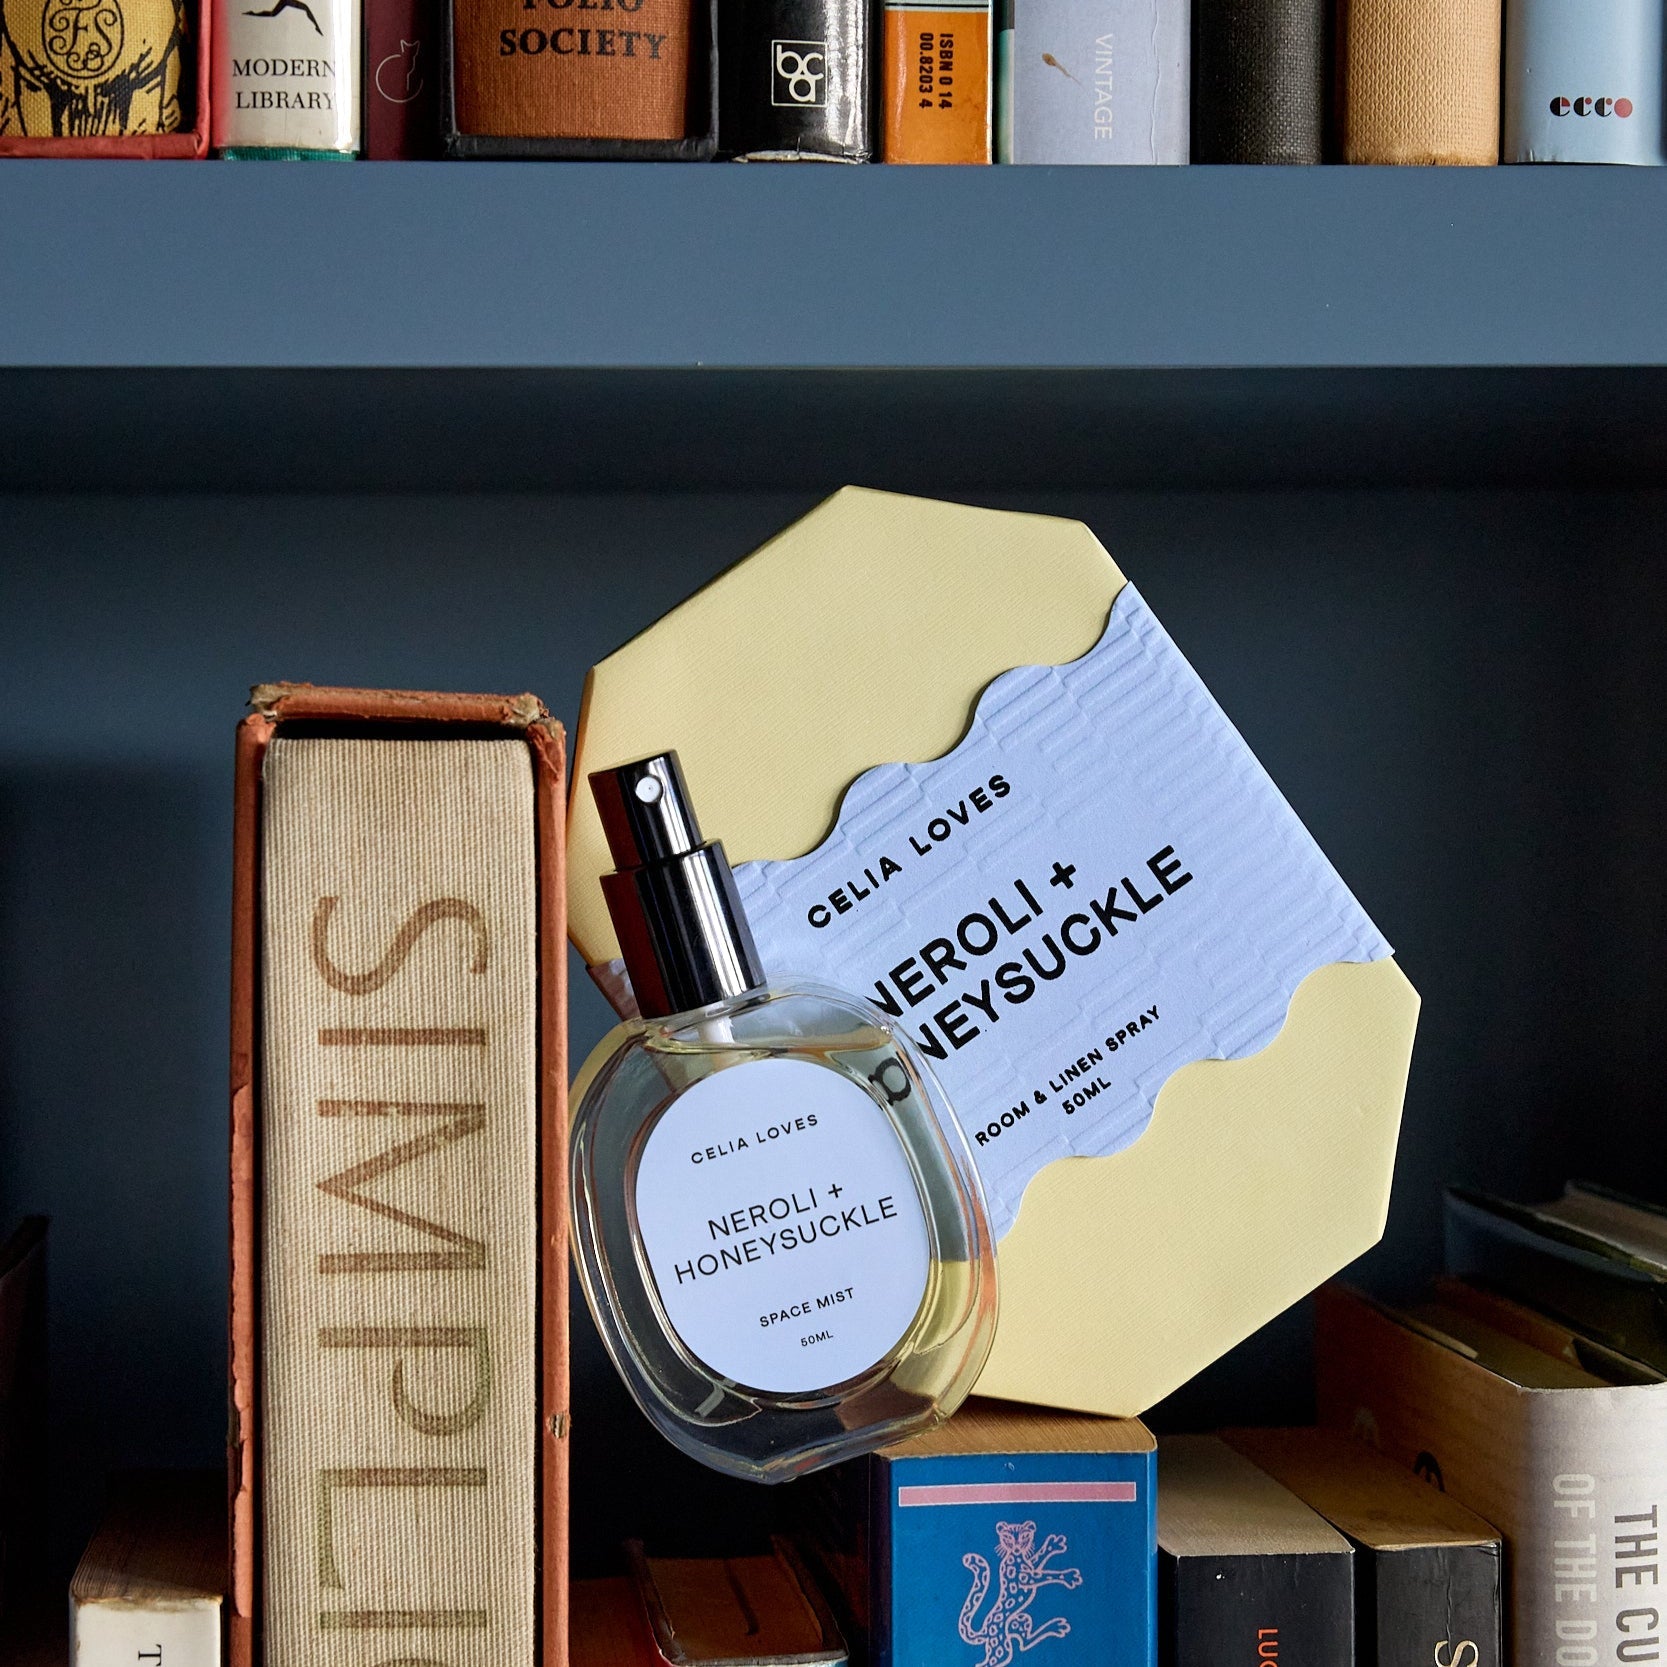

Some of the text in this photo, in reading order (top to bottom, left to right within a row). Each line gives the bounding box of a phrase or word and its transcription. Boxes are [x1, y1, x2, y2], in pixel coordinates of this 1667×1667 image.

[232, 59, 337, 78] MODERN
[499, 28, 667, 59] SOCIETY
[918, 32, 934, 109] 00.8203 4
[938, 33, 953, 109] ISBN 0 14
[235, 91, 336, 110] LIBRARY
[1094, 33, 1114, 140] VINTAGE
[808, 774, 1011, 929] CELIA LOVES
[863, 861, 1077, 1018] NEROLI +
[914, 844, 1194, 1061] NEYSUCKLE
[974, 1004, 1161, 1147] ROOM & LINEN SPRAY
[1061, 1076, 1112, 1116] 50ML
[690, 1114, 819, 1165] CELIA LOVES
[674, 1196, 898, 1285] HONEYSUCKLE
[707, 1183, 844, 1241] NEROLI +
[312, 896, 491, 1667] SIMPLI
[759, 1287, 855, 1329] SPACE MIST
[800, 1330, 835, 1348] 50ML
[1552, 1473, 1600, 1667] OF THE DO
[1614, 1504, 1660, 1663] THE CU
